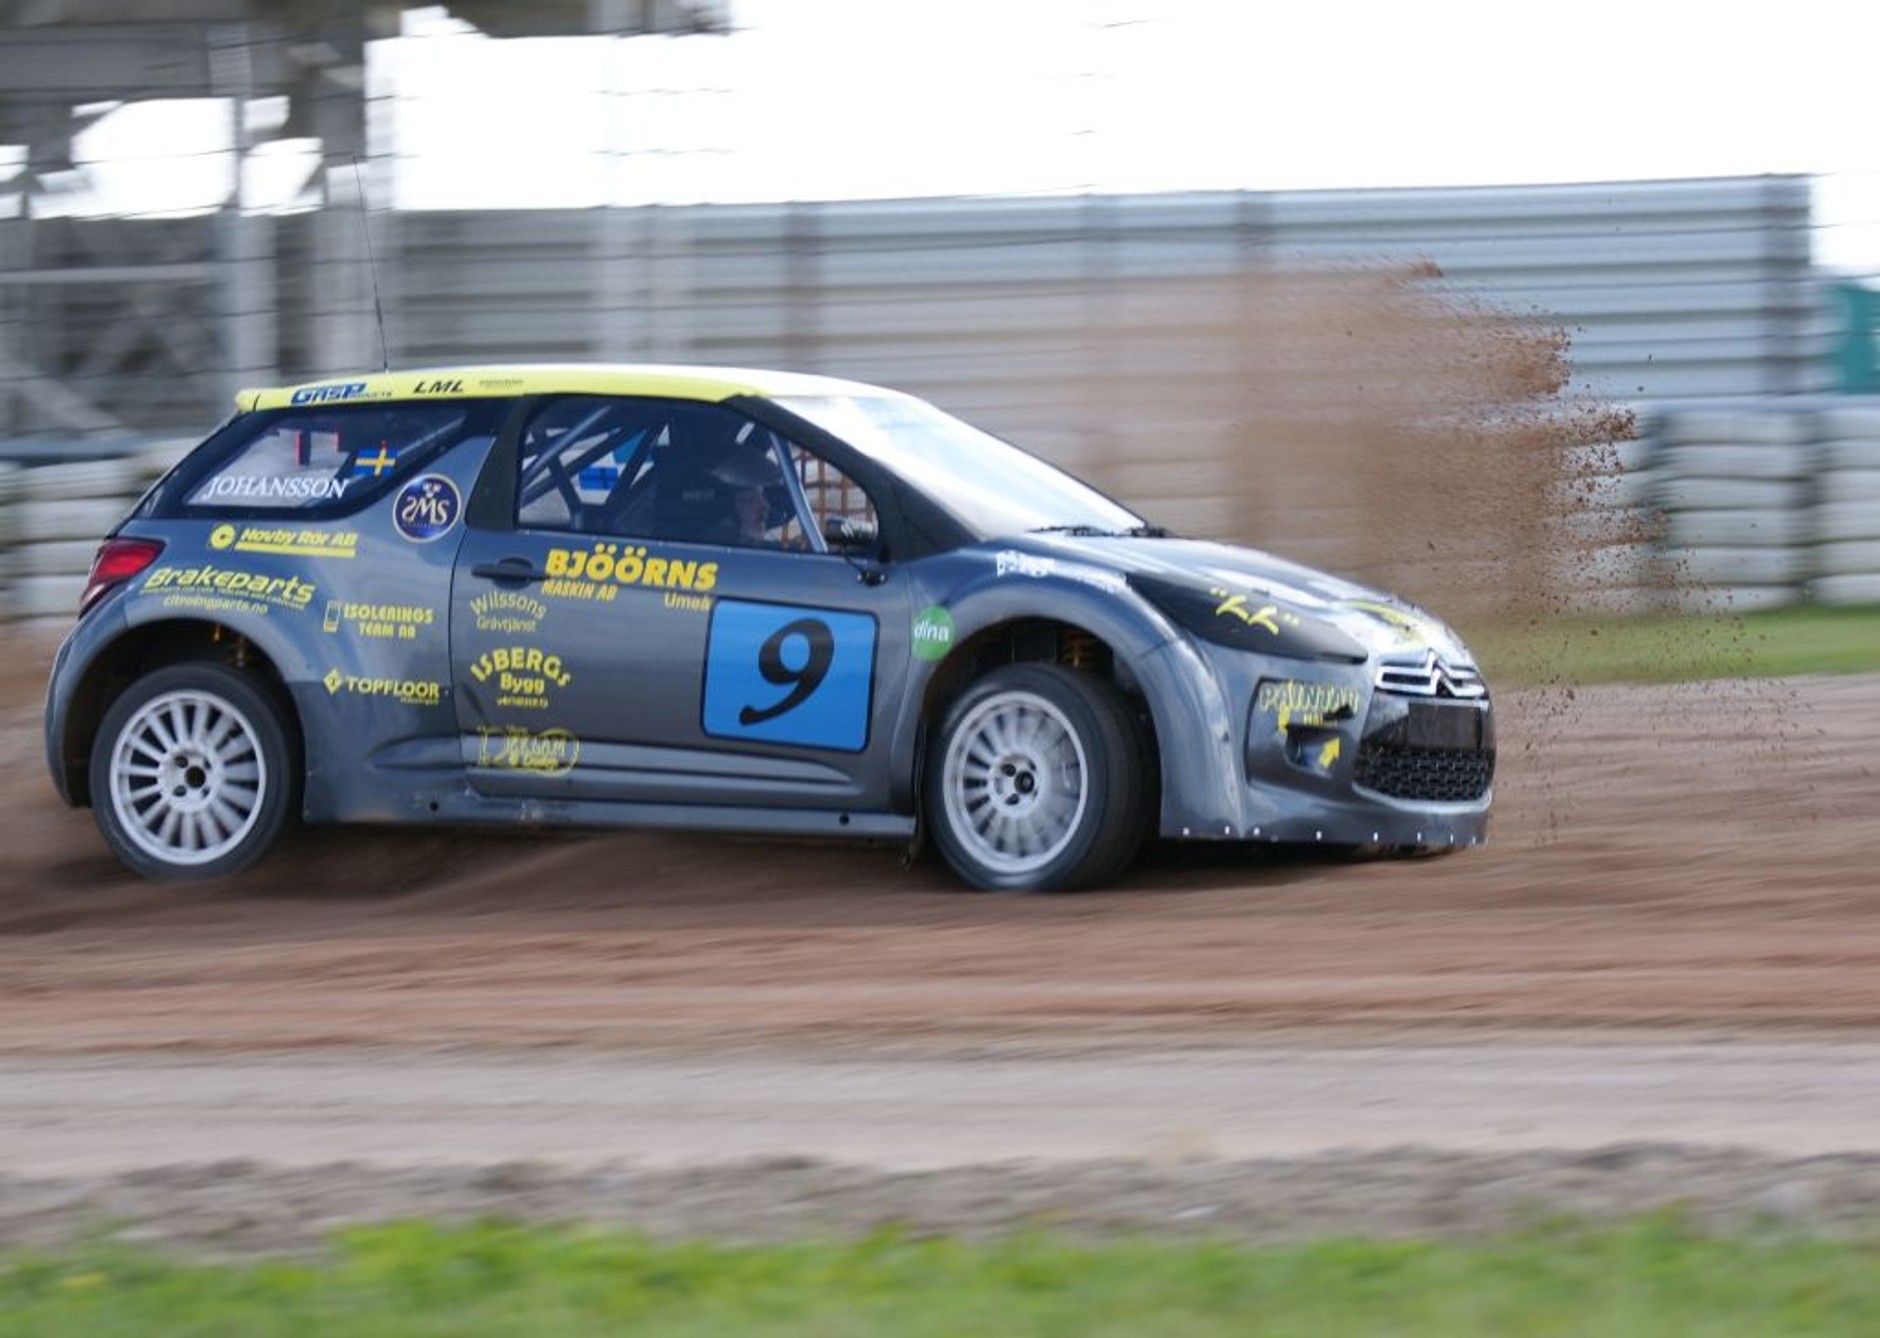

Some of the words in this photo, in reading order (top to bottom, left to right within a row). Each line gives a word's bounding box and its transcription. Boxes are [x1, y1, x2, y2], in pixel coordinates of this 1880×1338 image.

[413, 380, 464, 394] LML
[201, 475, 351, 501] JOHANSSON
[330, 533, 358, 546] AB
[545, 543, 719, 591] BJÖÖRNS
[145, 565, 316, 604] Brakeparts
[541, 579, 596, 599] MASKIN
[597, 584, 618, 601] AB
[469, 590, 547, 621] Wilssons
[500, 672, 545, 695] Bygg
[740, 618, 834, 726] 9
[345, 675, 440, 699] TOPFLOOR
